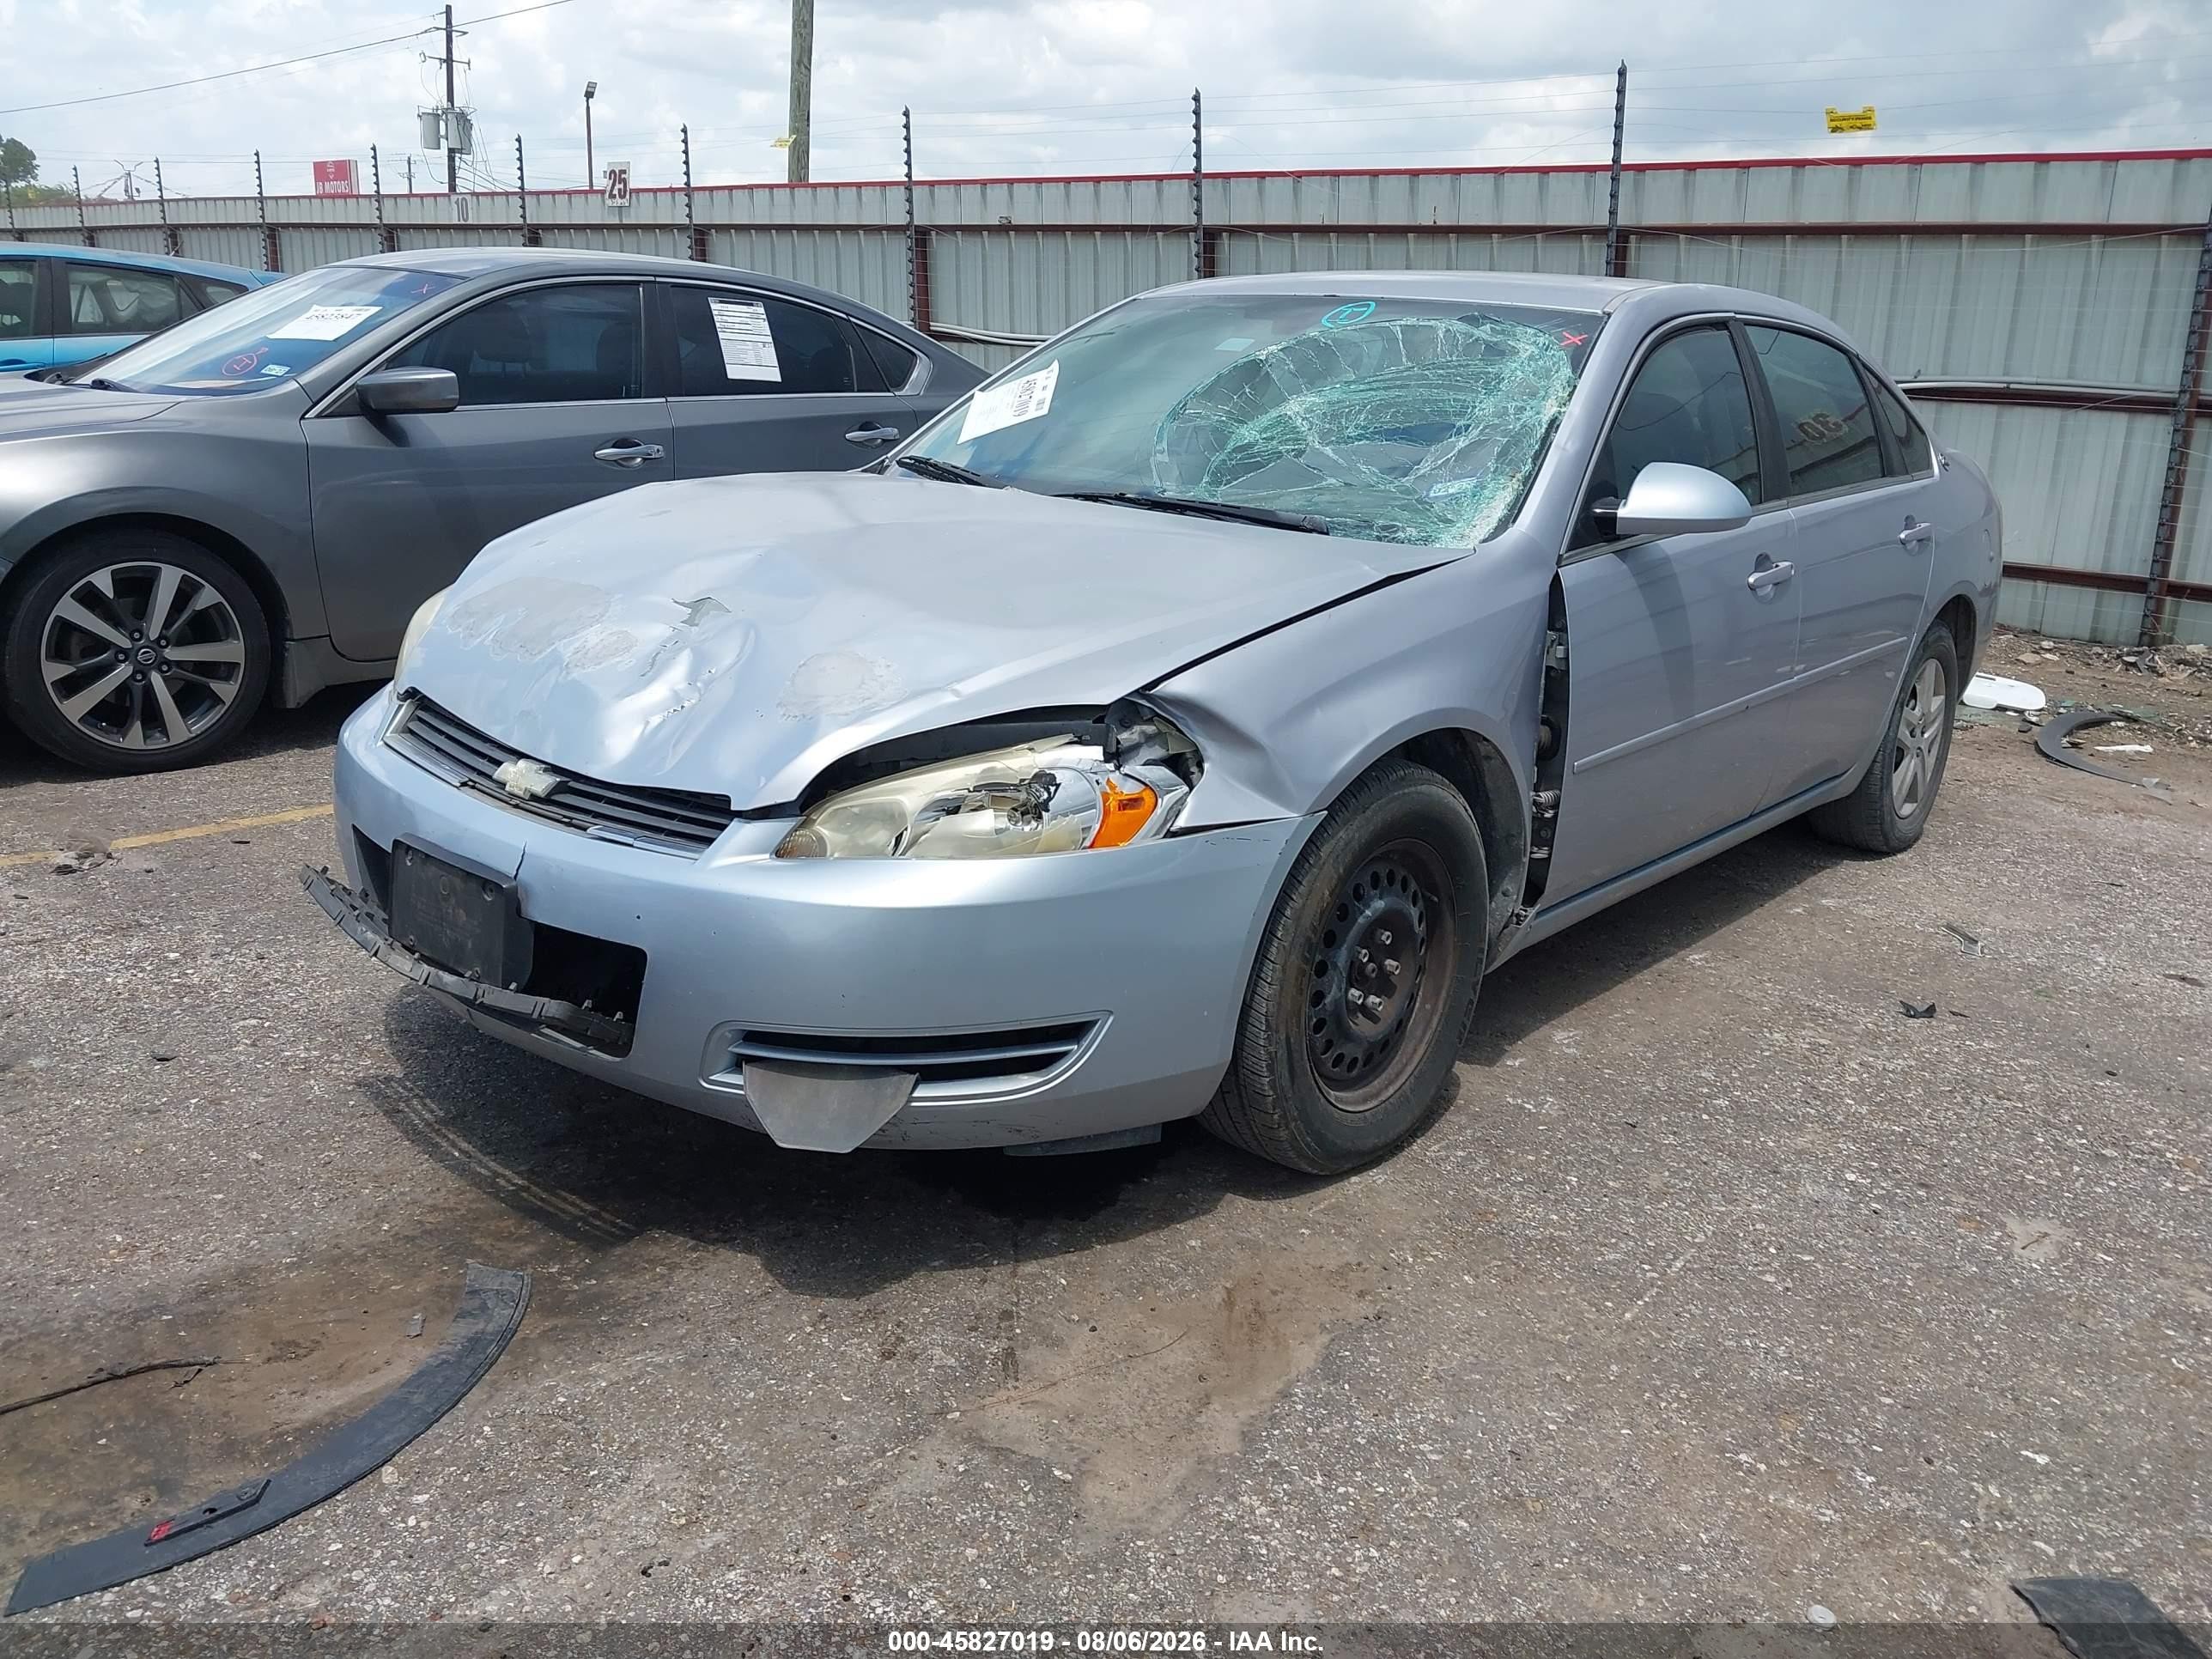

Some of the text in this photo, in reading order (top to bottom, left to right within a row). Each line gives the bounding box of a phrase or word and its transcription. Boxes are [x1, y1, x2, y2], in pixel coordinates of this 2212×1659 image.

[324, 180, 349, 194] MOTORS
[608, 168, 628, 199] 25
[454, 197, 470, 222] 10
[1012, 378, 1038, 417] 45827019
